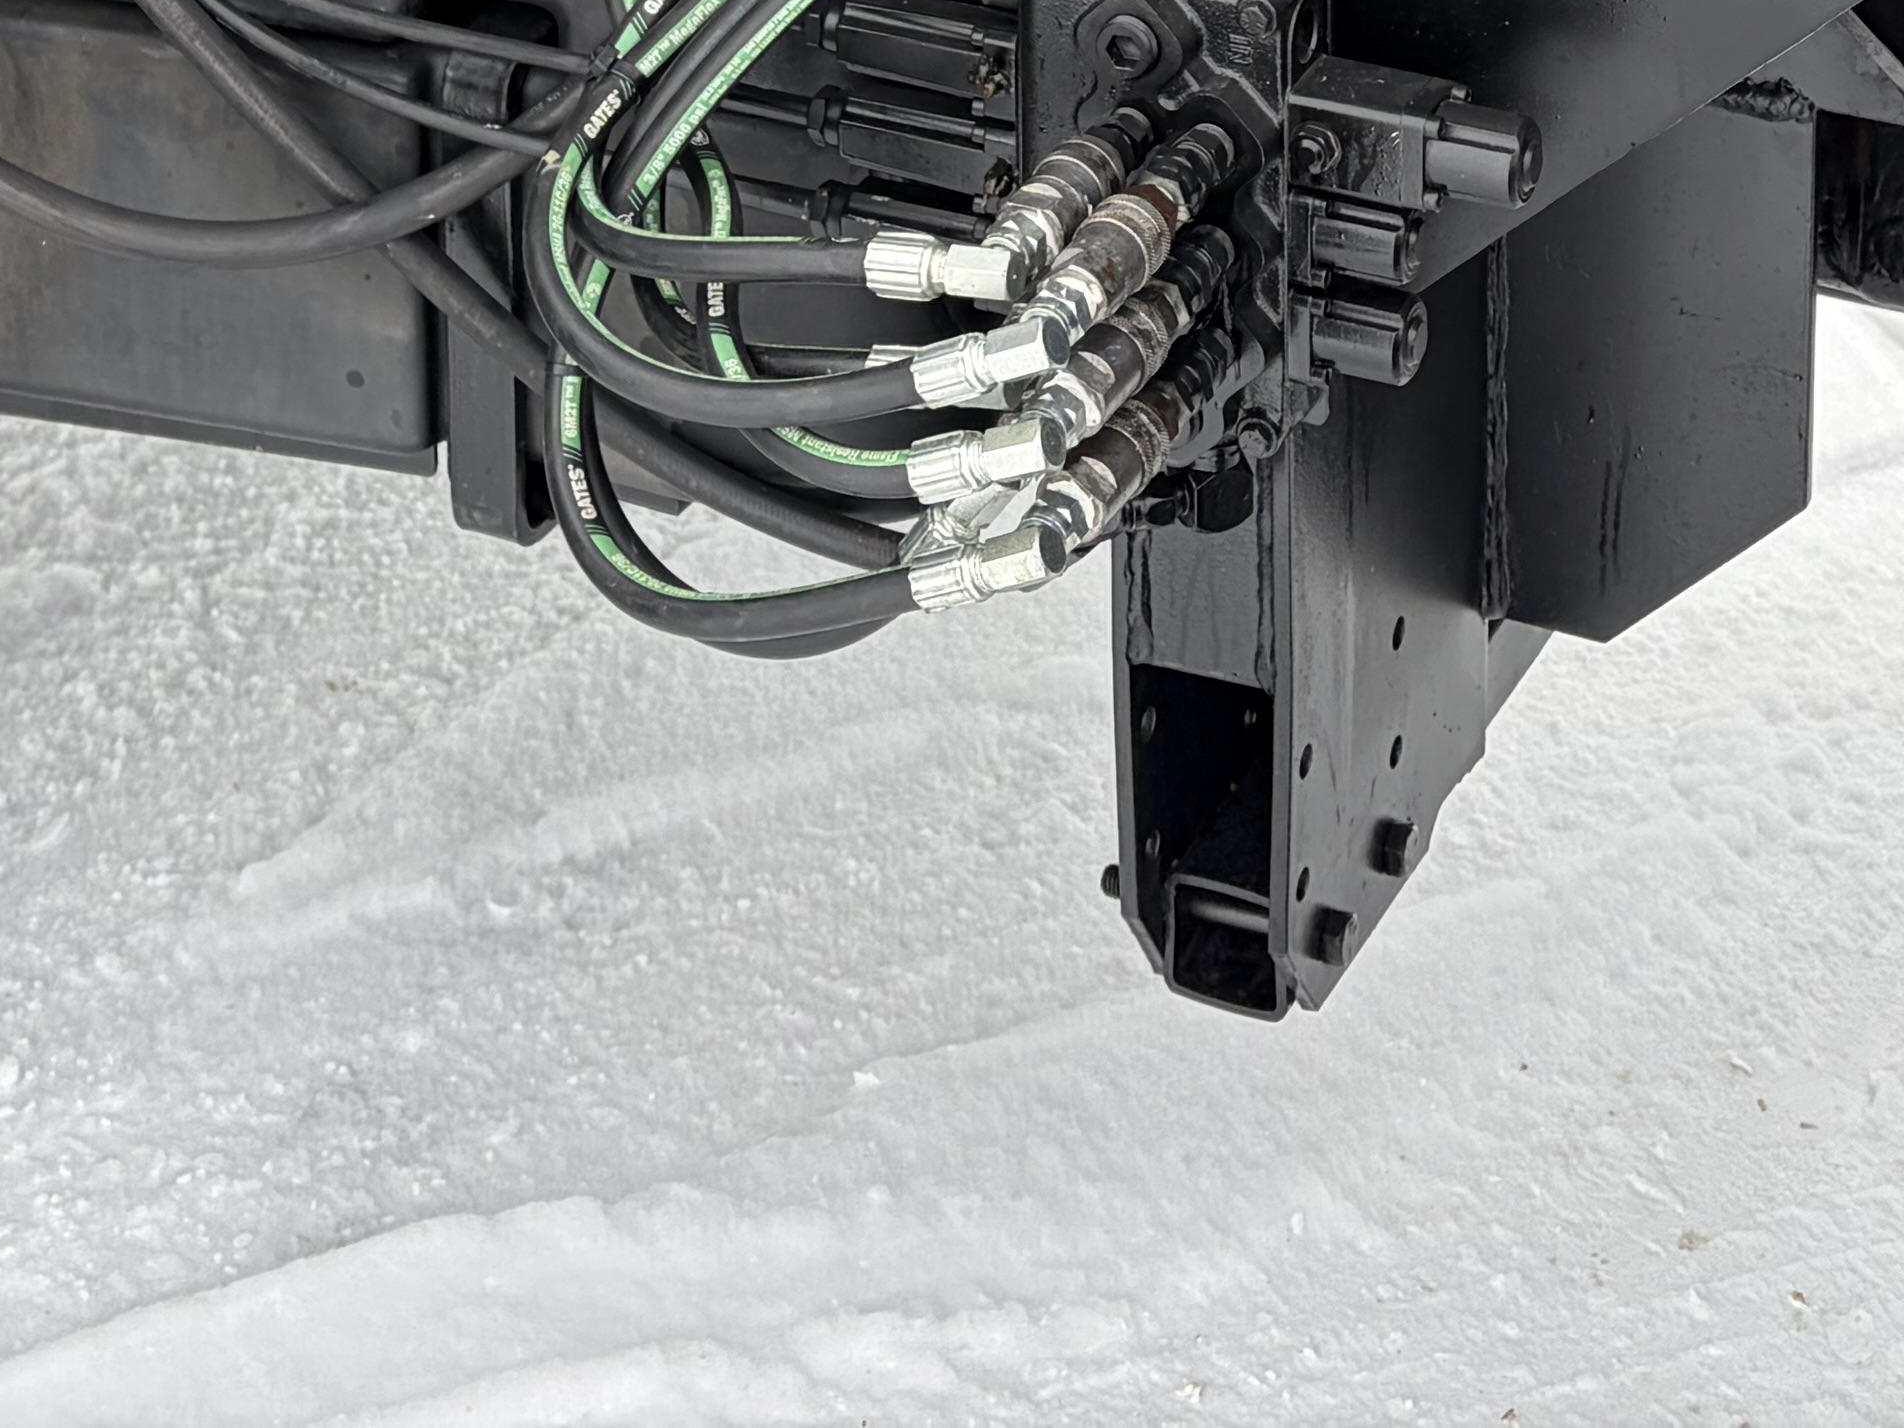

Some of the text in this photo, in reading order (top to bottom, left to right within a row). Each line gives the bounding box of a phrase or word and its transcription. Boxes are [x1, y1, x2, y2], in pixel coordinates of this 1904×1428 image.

[583, 93, 623, 141] GATES
[707, 280, 725, 318] GATE
[567, 463, 598, 520] GATES
